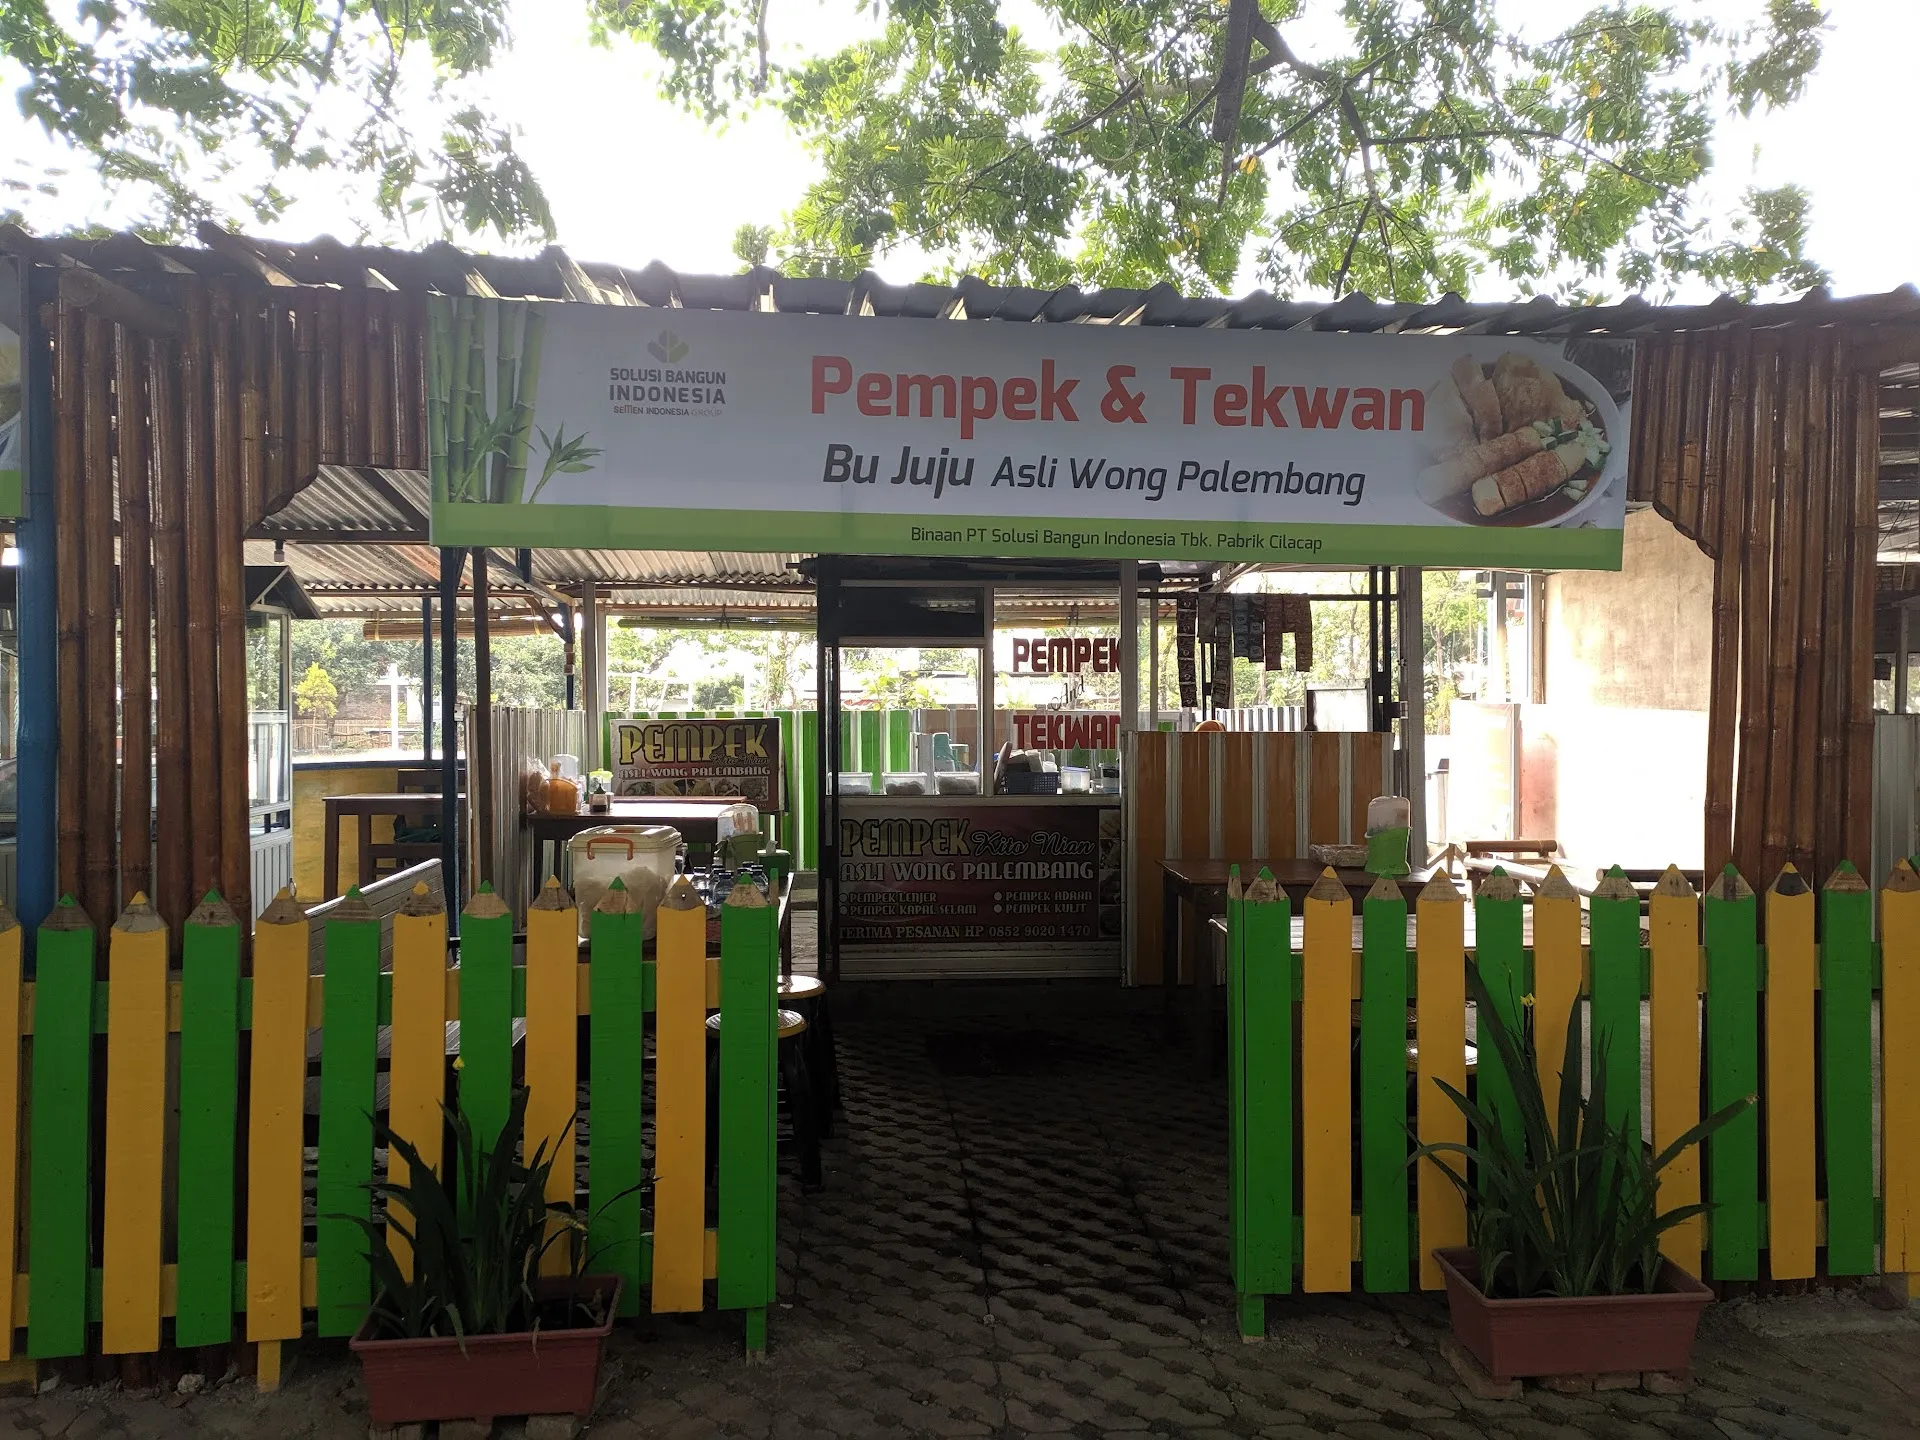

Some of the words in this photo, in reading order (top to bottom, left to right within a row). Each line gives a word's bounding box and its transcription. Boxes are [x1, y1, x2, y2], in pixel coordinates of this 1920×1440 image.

[609, 367, 662, 382] SOLUSI
[665, 369, 726, 385] BANGUN
[609, 384, 726, 405] INDONESIA
[810, 355, 1081, 440] Pempek
[1100, 364, 1148, 425] &
[1170, 365, 1426, 432] Tekwan
[646, 407, 690, 416] INDONESIA
[822, 442, 880, 484] Bu
[890, 445, 975, 500] Juju
[990, 454, 1059, 488] Asli
[1069, 457, 1168, 502] Wong
[1177, 460, 1366, 507] Palembang
[910, 526, 962, 543] Binaan
[966, 527, 988, 543] PT
[992, 528, 1039, 544] Solusi
[1043, 529, 1100, 549] Bangun
[1104, 530, 1176, 547] Indonesia
[1180, 531, 1213, 548] Tbk.
[1216, 533, 1265, 549] Pabrik
[1269, 533, 1323, 555] Cilacap
[1012, 637, 1121, 673] PEMPEK
[618, 723, 770, 765] PEMPEK
[619, 768, 650, 779] ASLI
[651, 767, 688, 777] WONG
[691, 765, 771, 777] PALEMBANG
[840, 818, 971, 857] PEMPEK
[840, 862, 885, 881] ASLI
[891, 861, 957, 881] WONG
[962, 861, 1094, 880] PALEMBANG
[849, 892, 896, 903] PEMPEK
[1005, 891, 1051, 902] PEMPEK
[849, 905, 896, 916] PEMPEK
[899, 904, 937, 915] KAPAL
[939, 904, 977, 915] SELAM
[1005, 903, 1051, 914] PEMPEK
[896, 925, 961, 938] PESANAN
[964, 925, 985, 937] HP
[988, 926, 1020, 938] 0852
[1024, 925, 1056, 937] 9020
[1059, 925, 1091, 937] 1470
